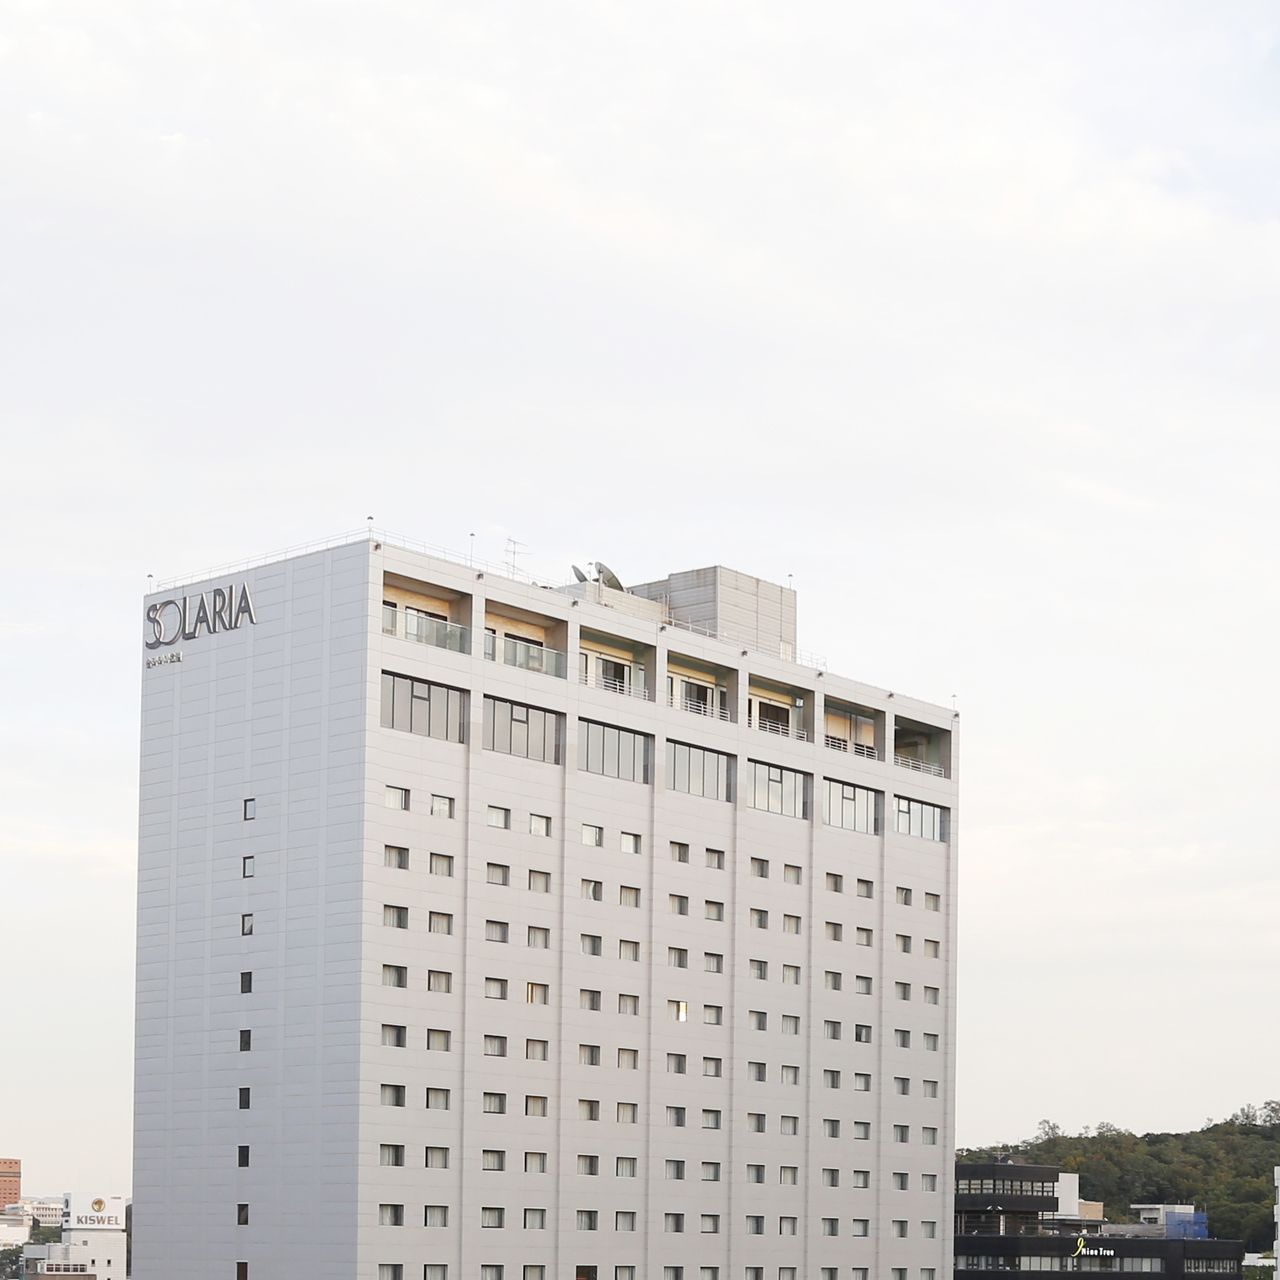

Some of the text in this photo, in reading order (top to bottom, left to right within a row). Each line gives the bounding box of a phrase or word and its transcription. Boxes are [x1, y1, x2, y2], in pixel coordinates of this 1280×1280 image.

[145, 582, 257, 650] SOLARIA
[76, 1215, 121, 1225] KISWEL
[1099, 1247, 1115, 1256] Tree
